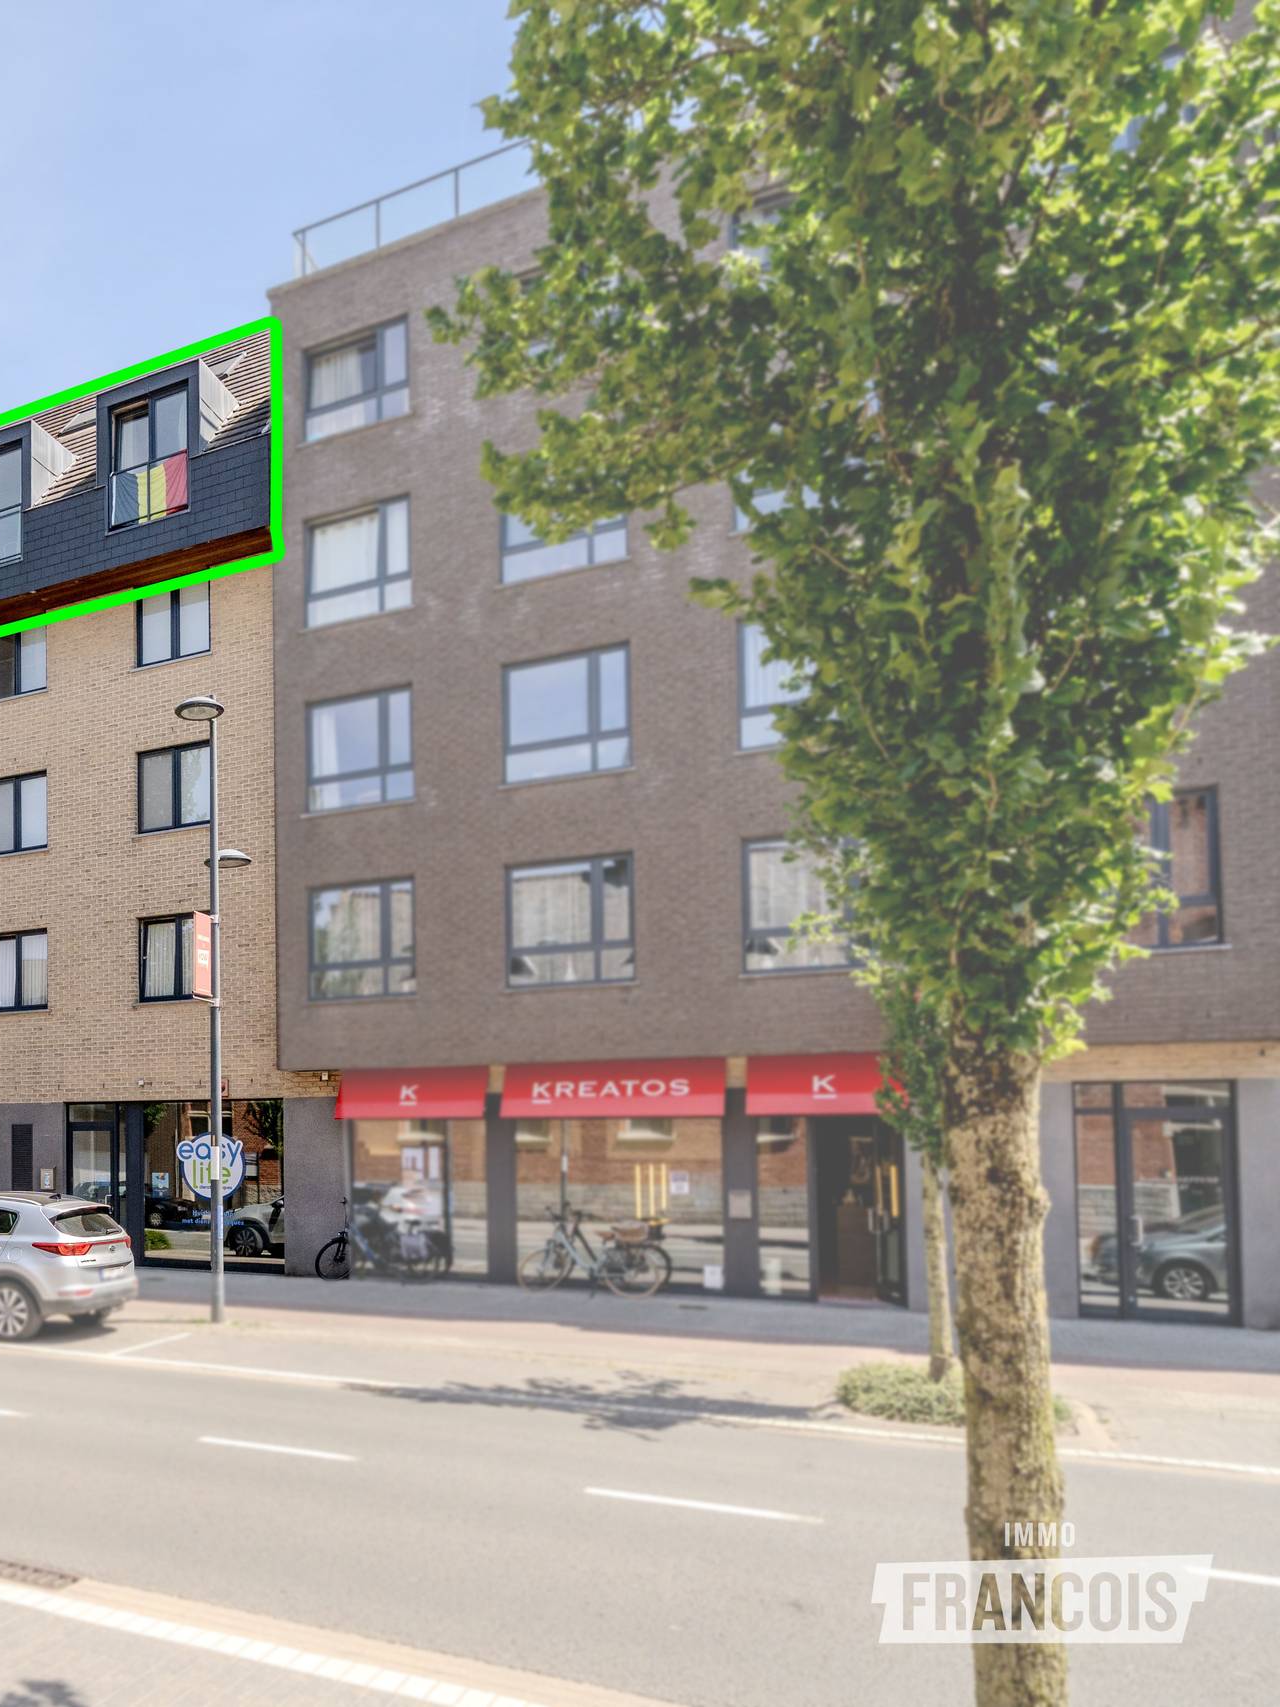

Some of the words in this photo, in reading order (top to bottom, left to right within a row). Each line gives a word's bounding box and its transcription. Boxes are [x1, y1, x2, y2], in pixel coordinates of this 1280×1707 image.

[400, 1084, 419, 1106] K
[531, 1078, 690, 1104] KREATOS
[813, 1074, 837, 1099] K
